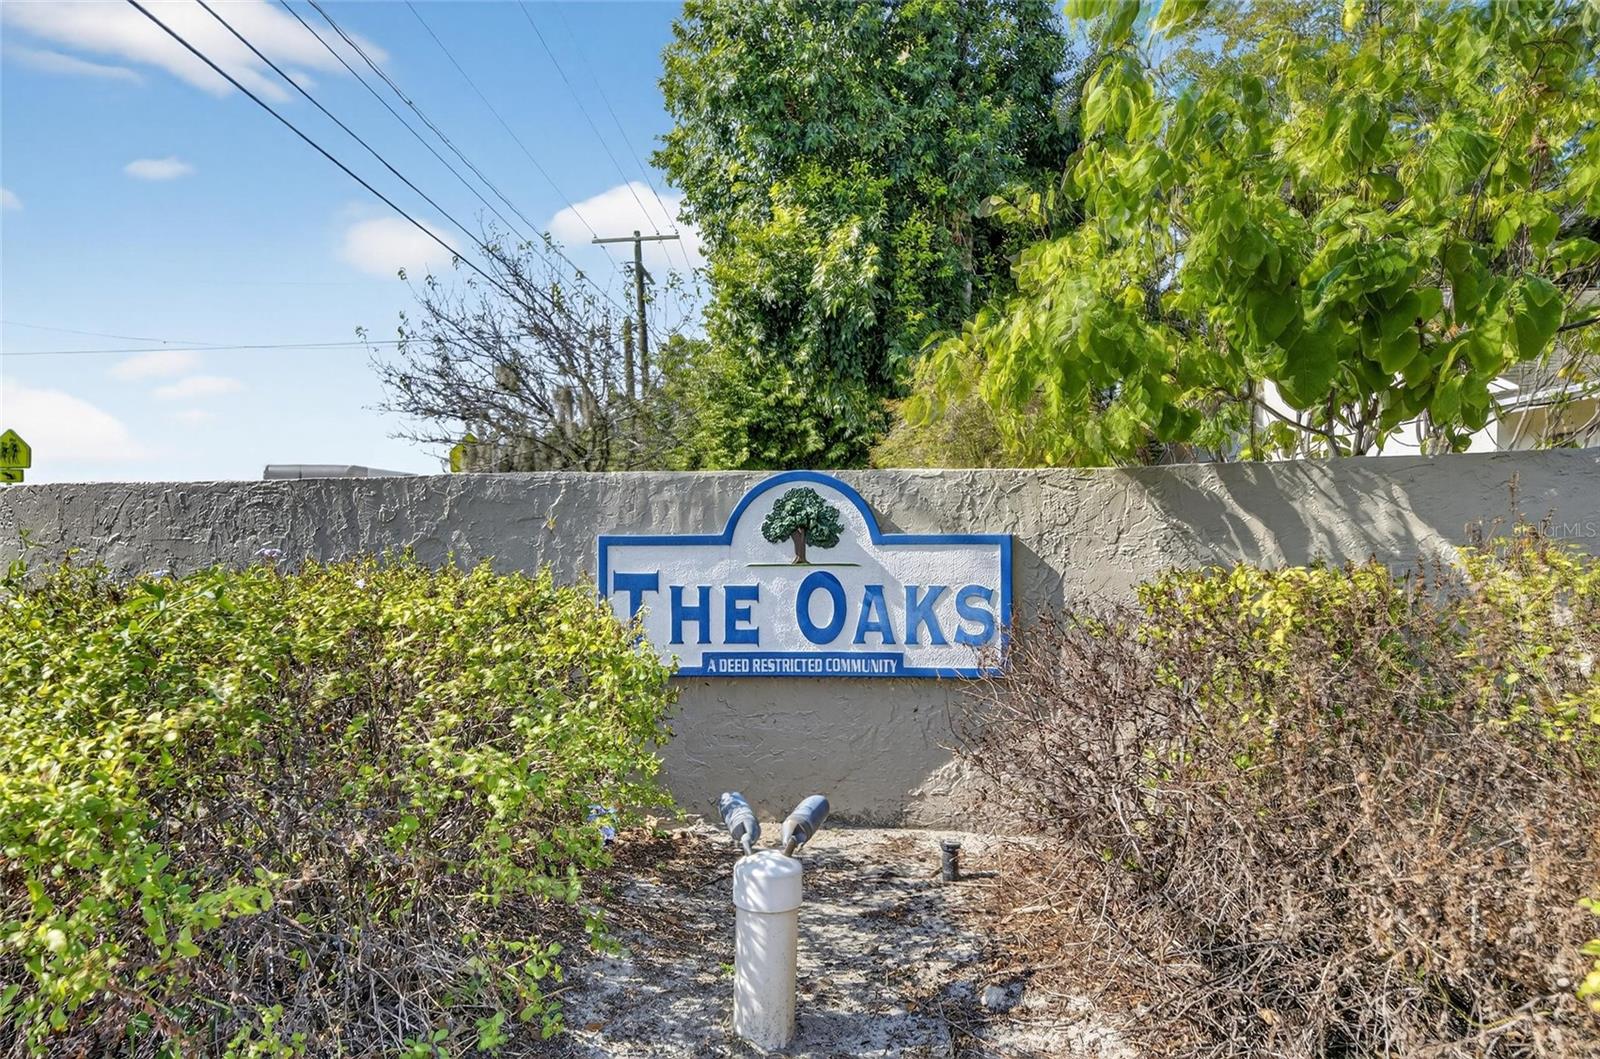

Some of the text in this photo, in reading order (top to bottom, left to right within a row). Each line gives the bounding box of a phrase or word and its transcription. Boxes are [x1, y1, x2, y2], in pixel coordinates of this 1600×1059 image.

[613, 570, 995, 647] THE OAKS
[706, 657, 898, 673] A DEED RESTRICTED COMMUNITY
